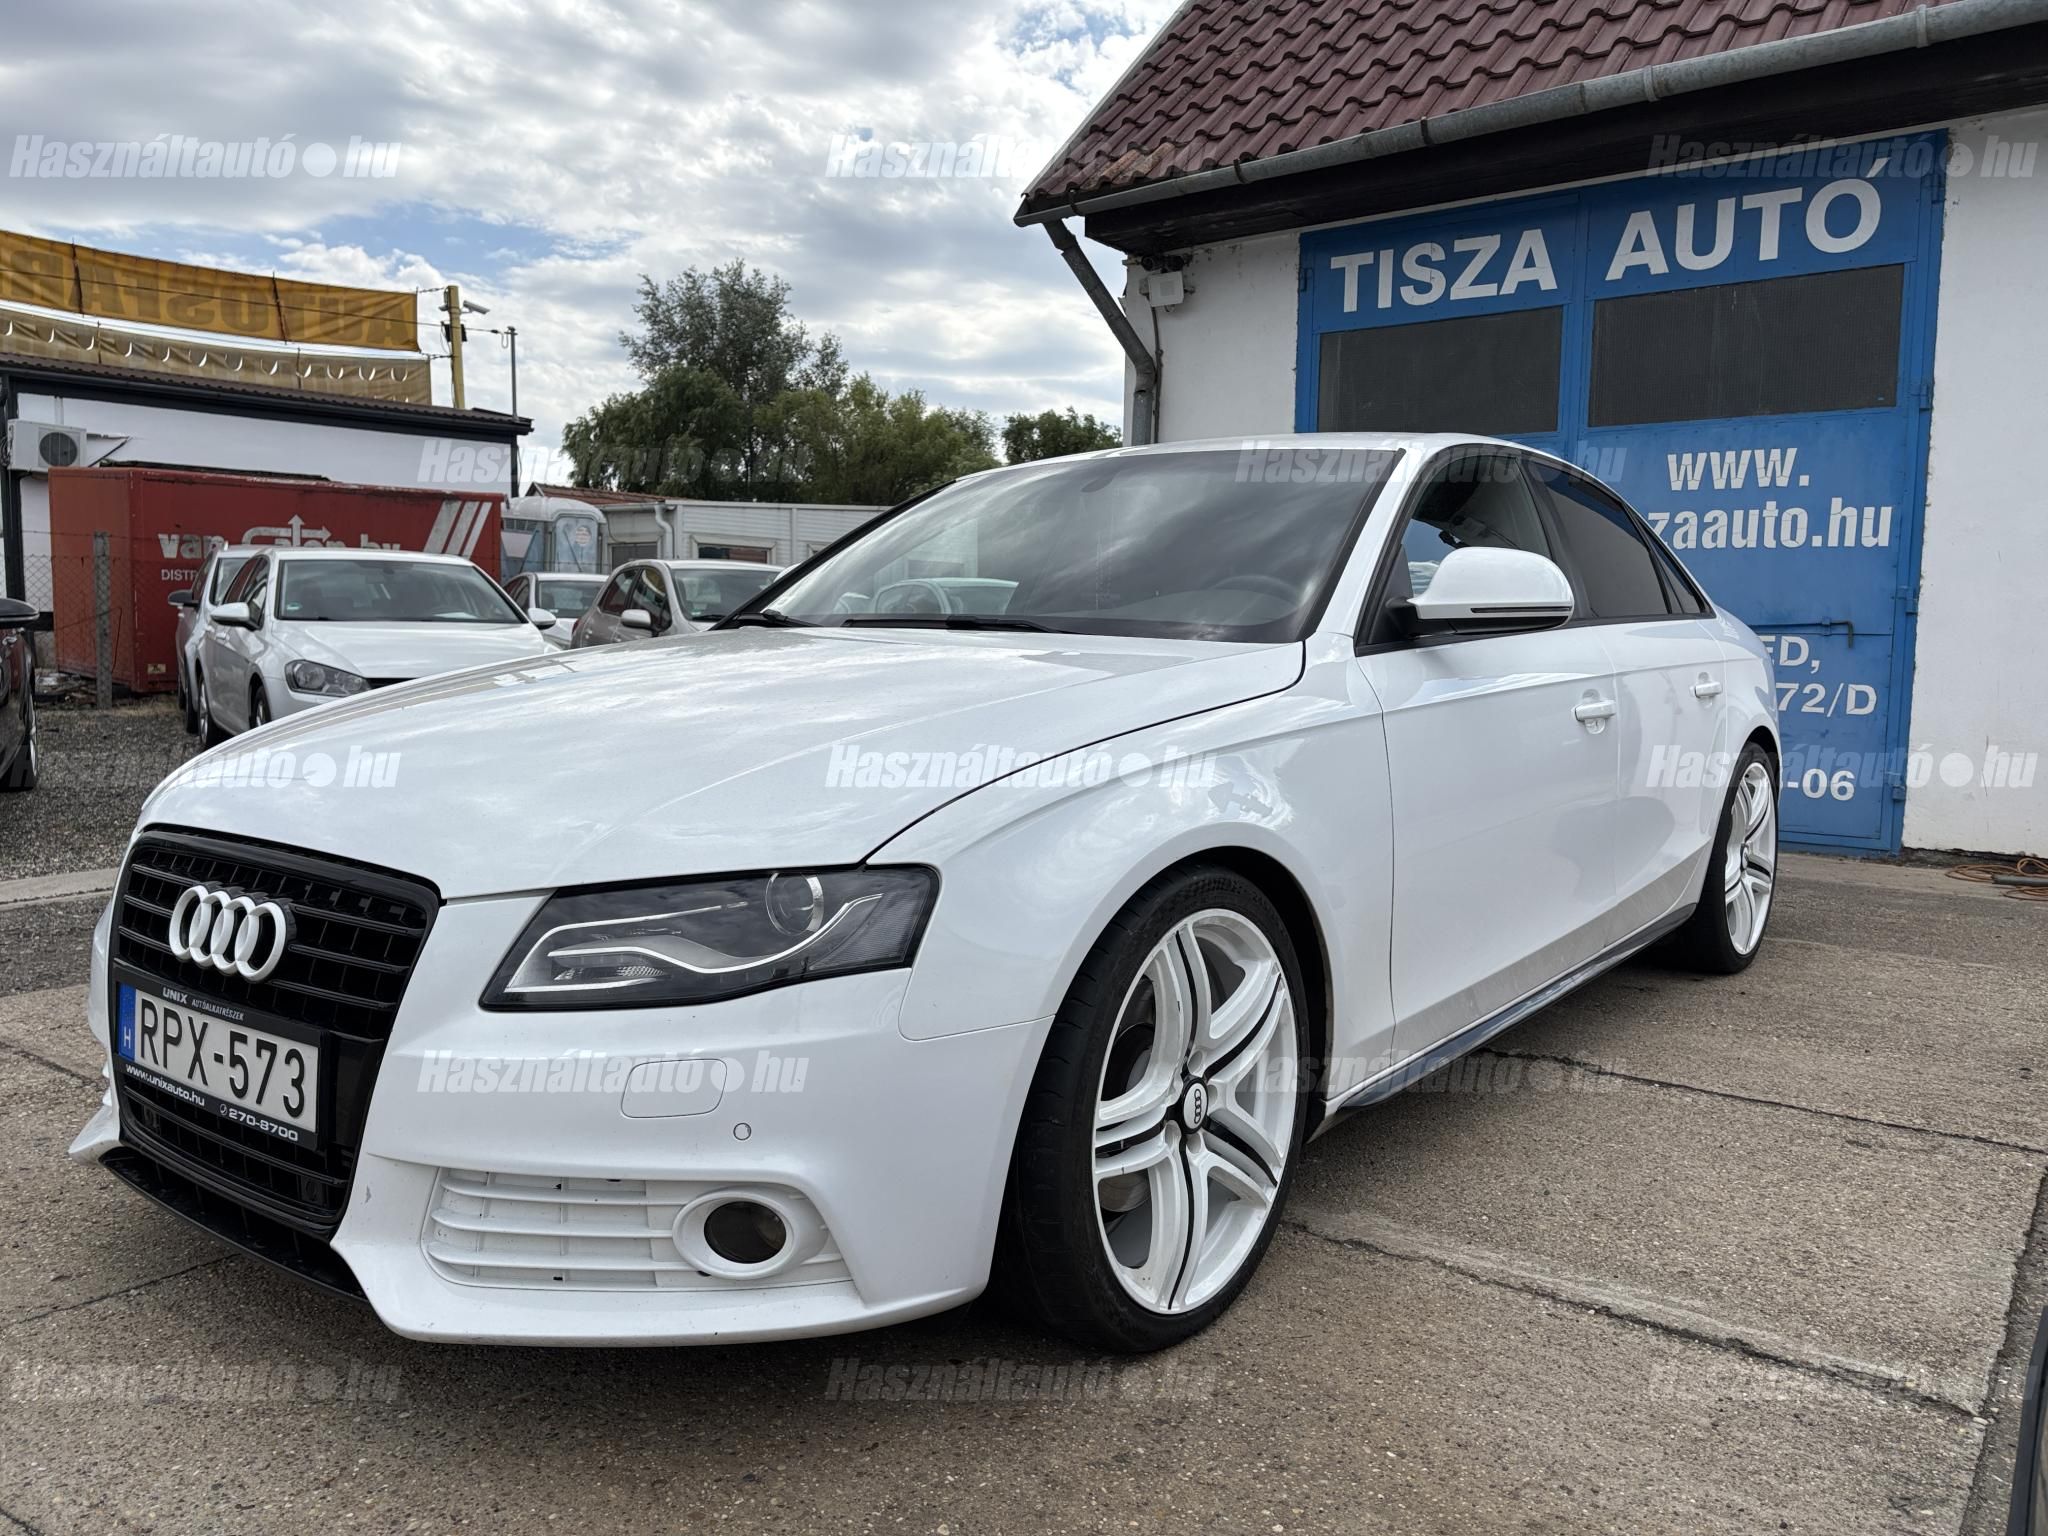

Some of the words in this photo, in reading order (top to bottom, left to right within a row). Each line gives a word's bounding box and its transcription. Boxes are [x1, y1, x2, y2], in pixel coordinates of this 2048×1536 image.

[1331, 229, 1559, 314] TISZA
[1605, 158, 1888, 282] AUTÓ
[1667, 447, 1811, 492] www.
[162, 986, 189, 1005] UNIX
[123, 1027, 132, 1050] H
[140, 997, 306, 1119] RPX-573
[125, 1063, 206, 1107] www.unixauto.hu
[228, 1108, 299, 1142] 270-8700
